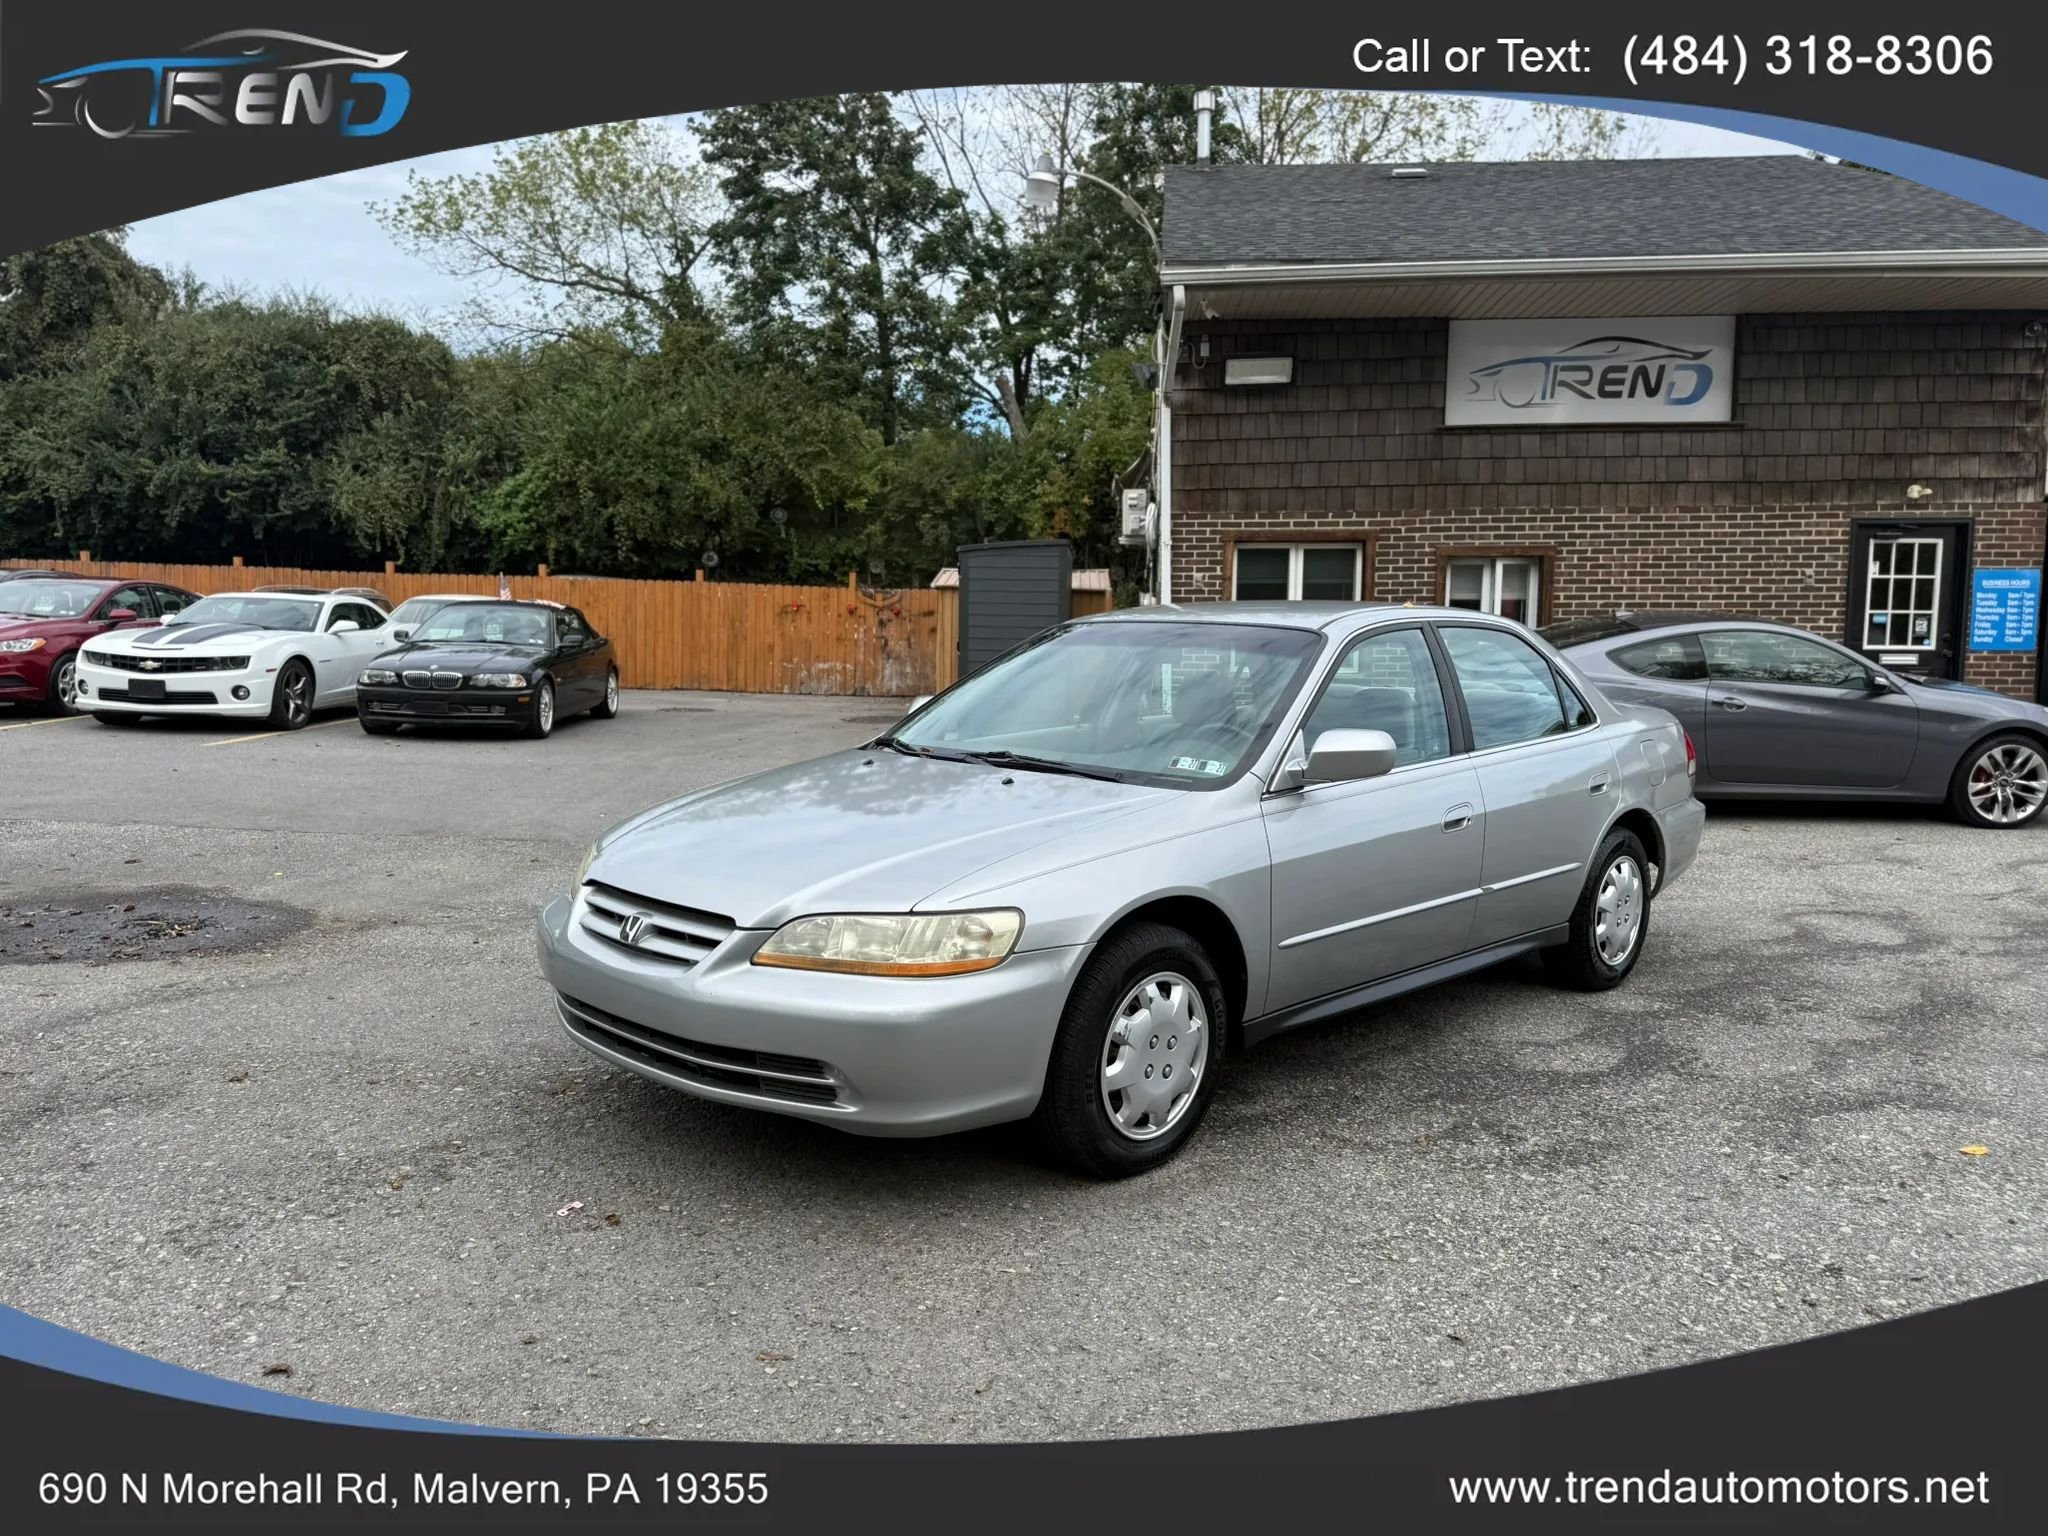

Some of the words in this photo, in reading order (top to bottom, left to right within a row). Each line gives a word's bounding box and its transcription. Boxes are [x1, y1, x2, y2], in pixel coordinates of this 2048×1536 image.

[1502, 356, 1714, 406] TREND
[1982, 579, 2009, 588] BUSINESS
[2010, 579, 2030, 588] HOURS
[1976, 592, 1997, 600] Monday
[1976, 600, 1998, 608] Tuesday
[1976, 607, 2006, 615] Wednesday
[1976, 614, 2000, 622] Thursday
[1974, 621, 1992, 630] Friday
[1974, 629, 1998, 637] Saturday
[1974, 636, 1994, 644] Sunday
